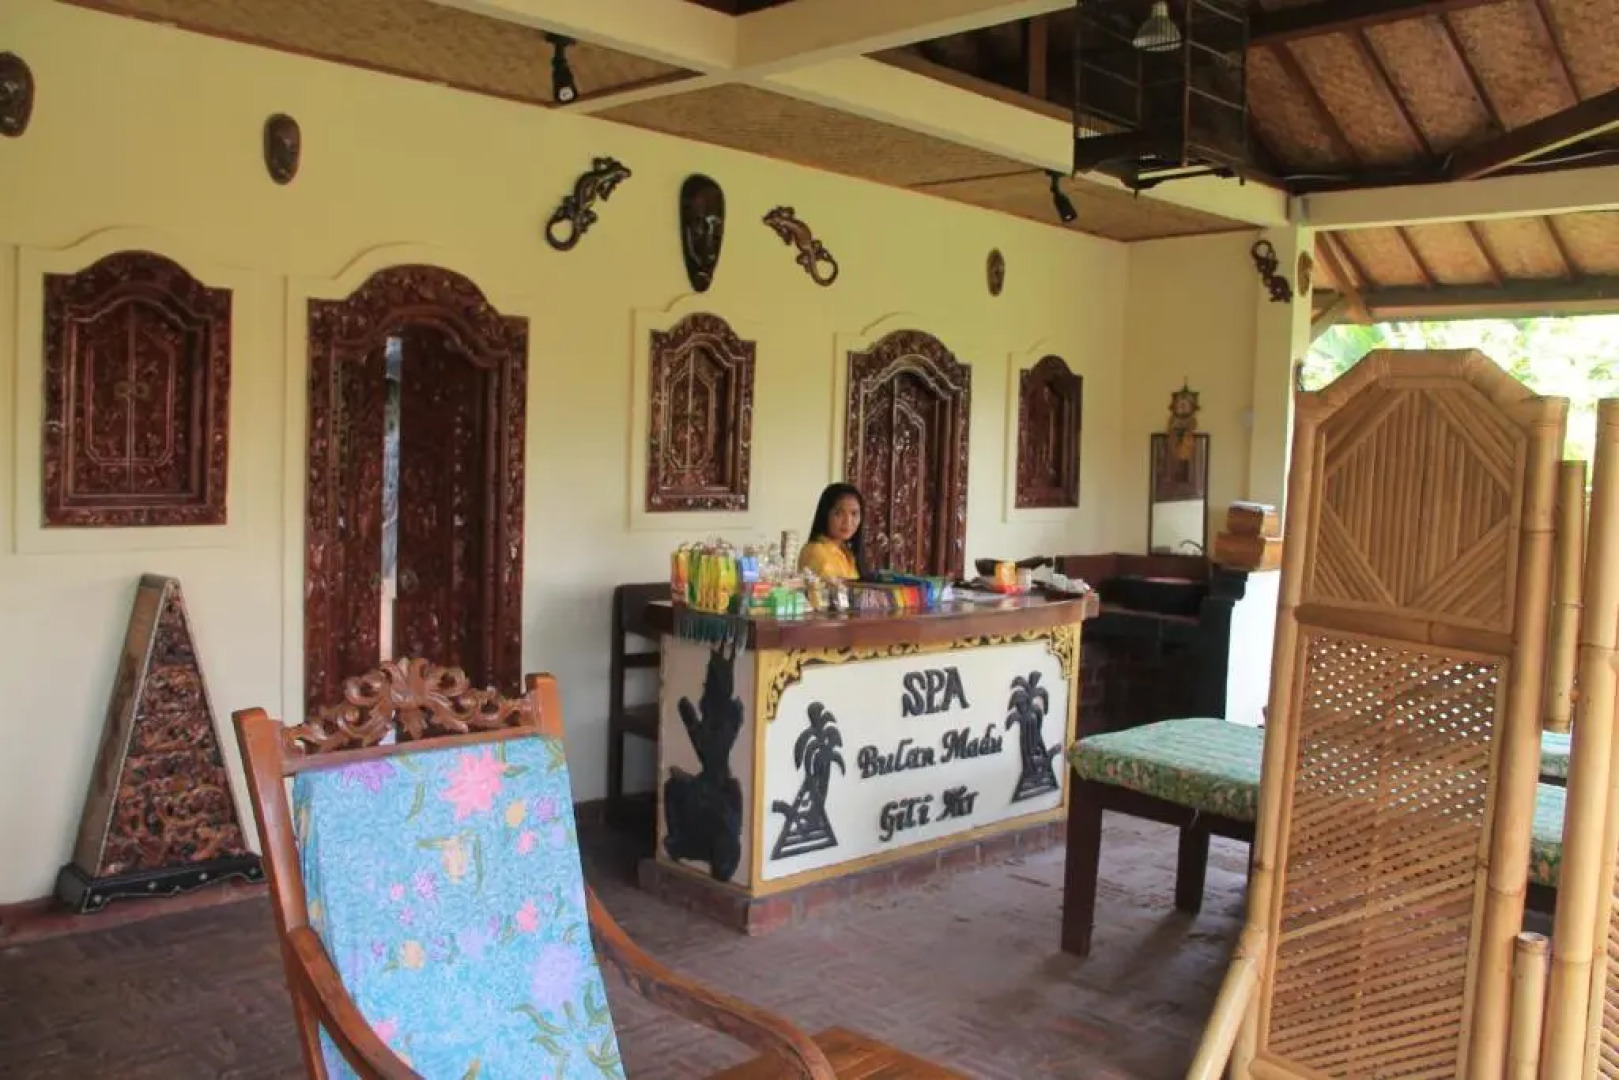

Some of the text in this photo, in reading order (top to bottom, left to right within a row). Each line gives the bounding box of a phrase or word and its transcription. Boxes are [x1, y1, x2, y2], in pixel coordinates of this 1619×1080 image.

[902, 666, 970, 717] SPA
[857, 723, 1003, 778] Bulan Madu
